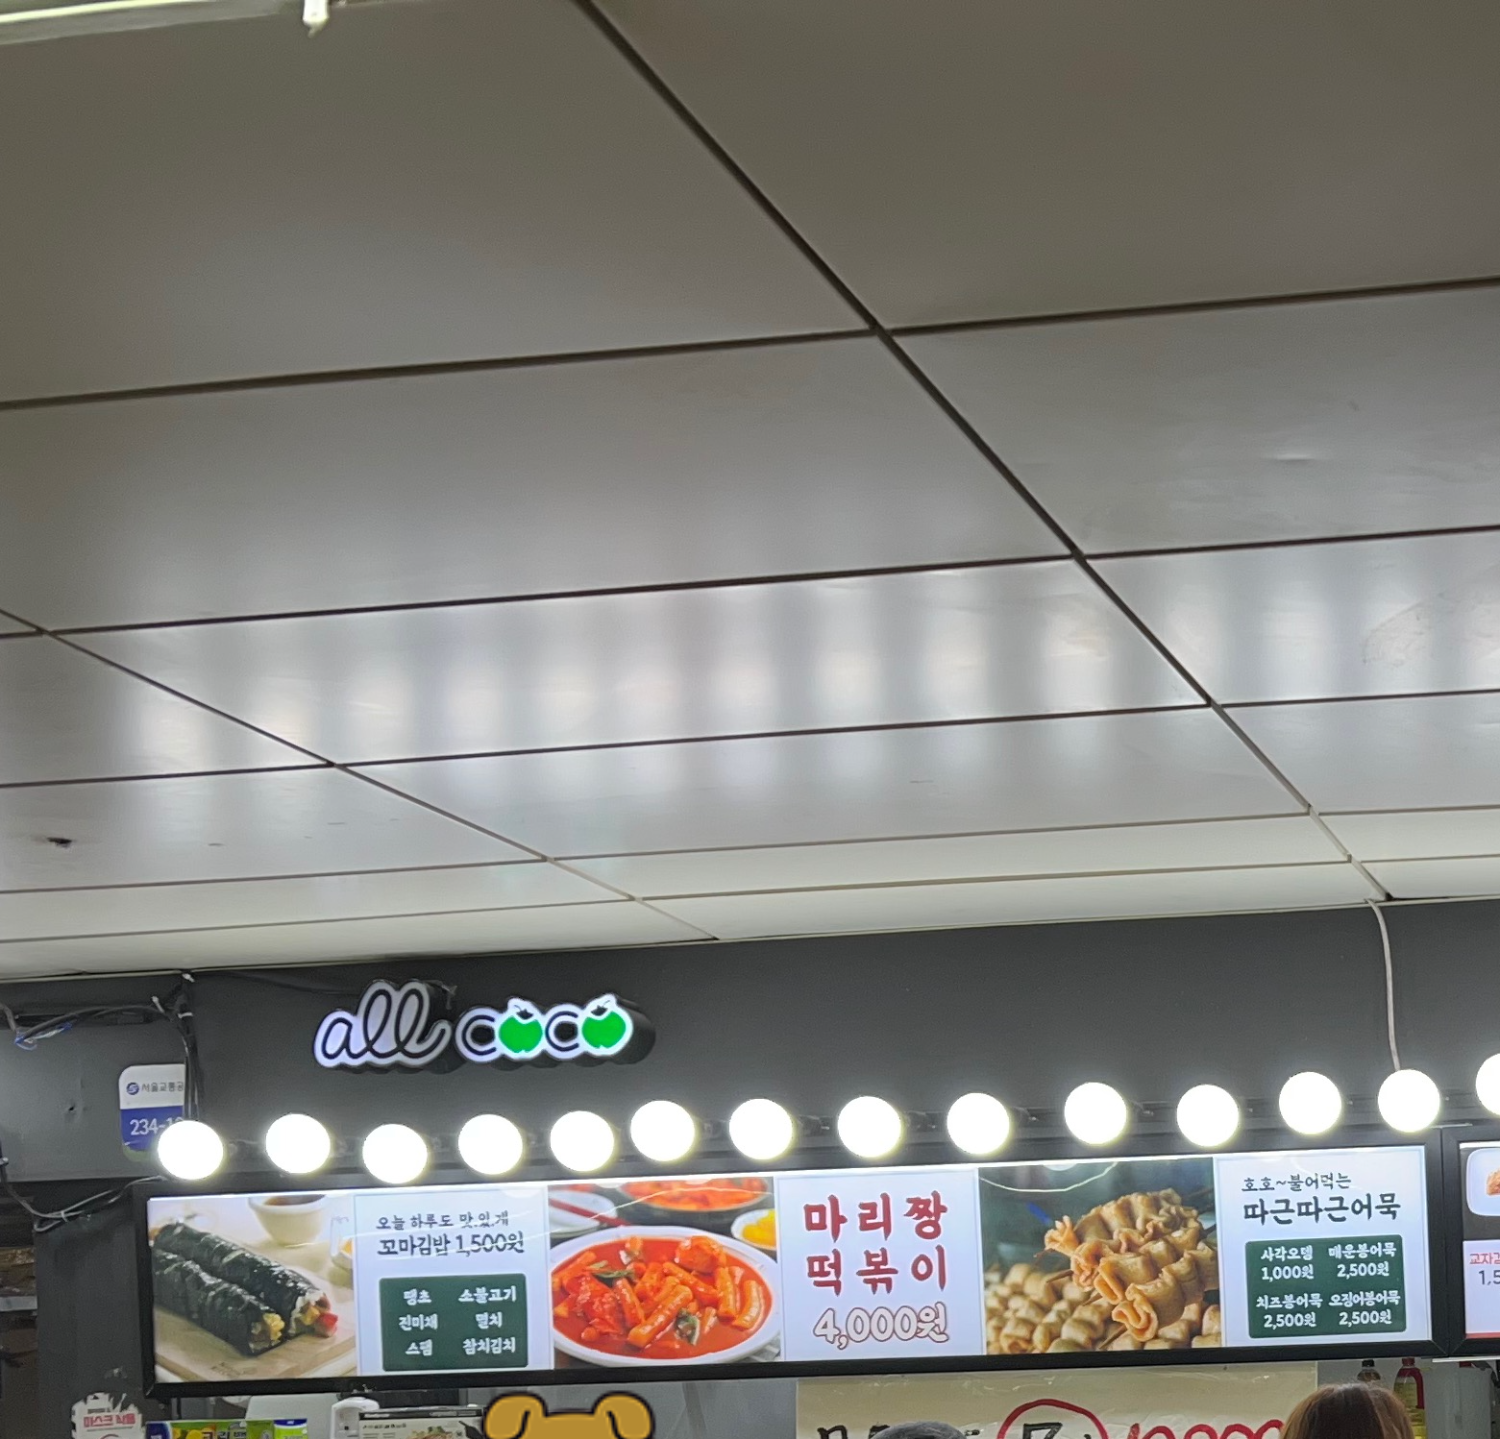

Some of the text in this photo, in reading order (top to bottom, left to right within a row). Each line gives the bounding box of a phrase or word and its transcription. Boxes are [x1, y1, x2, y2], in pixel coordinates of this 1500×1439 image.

[315, 981, 452, 1067] all
[1244, 1193, 1401, 1225] 따근따근어묵
[376, 1215, 405, 1230] 오늘
[411, 1214, 453, 1228] 하루도
[377, 1231, 524, 1256] 꼬마김밥 1,500원
[1328, 1242, 1397, 1259] 매운봉어묵
[1261, 1245, 1313, 1261] 사각오뎅
[1262, 1264, 1314, 1282] 1,000원
[1337, 1261, 1390, 1279] 2,500원
[458, 1286, 516, 1303] 소불고기
[1256, 1293, 1323, 1309] 치즈봉어묵
[1329, 1290, 1401, 1306] 오징어봉어묵
[399, 1314, 438, 1331] 진미채
[475, 1312, 502, 1329] 멸치
[813, 1301, 949, 1350] 4,000원
[1264, 1312, 1316, 1330] 2,500원
[1339, 1309, 1392, 1327] 2,500원
[463, 1337, 515, 1355] 참치김치
